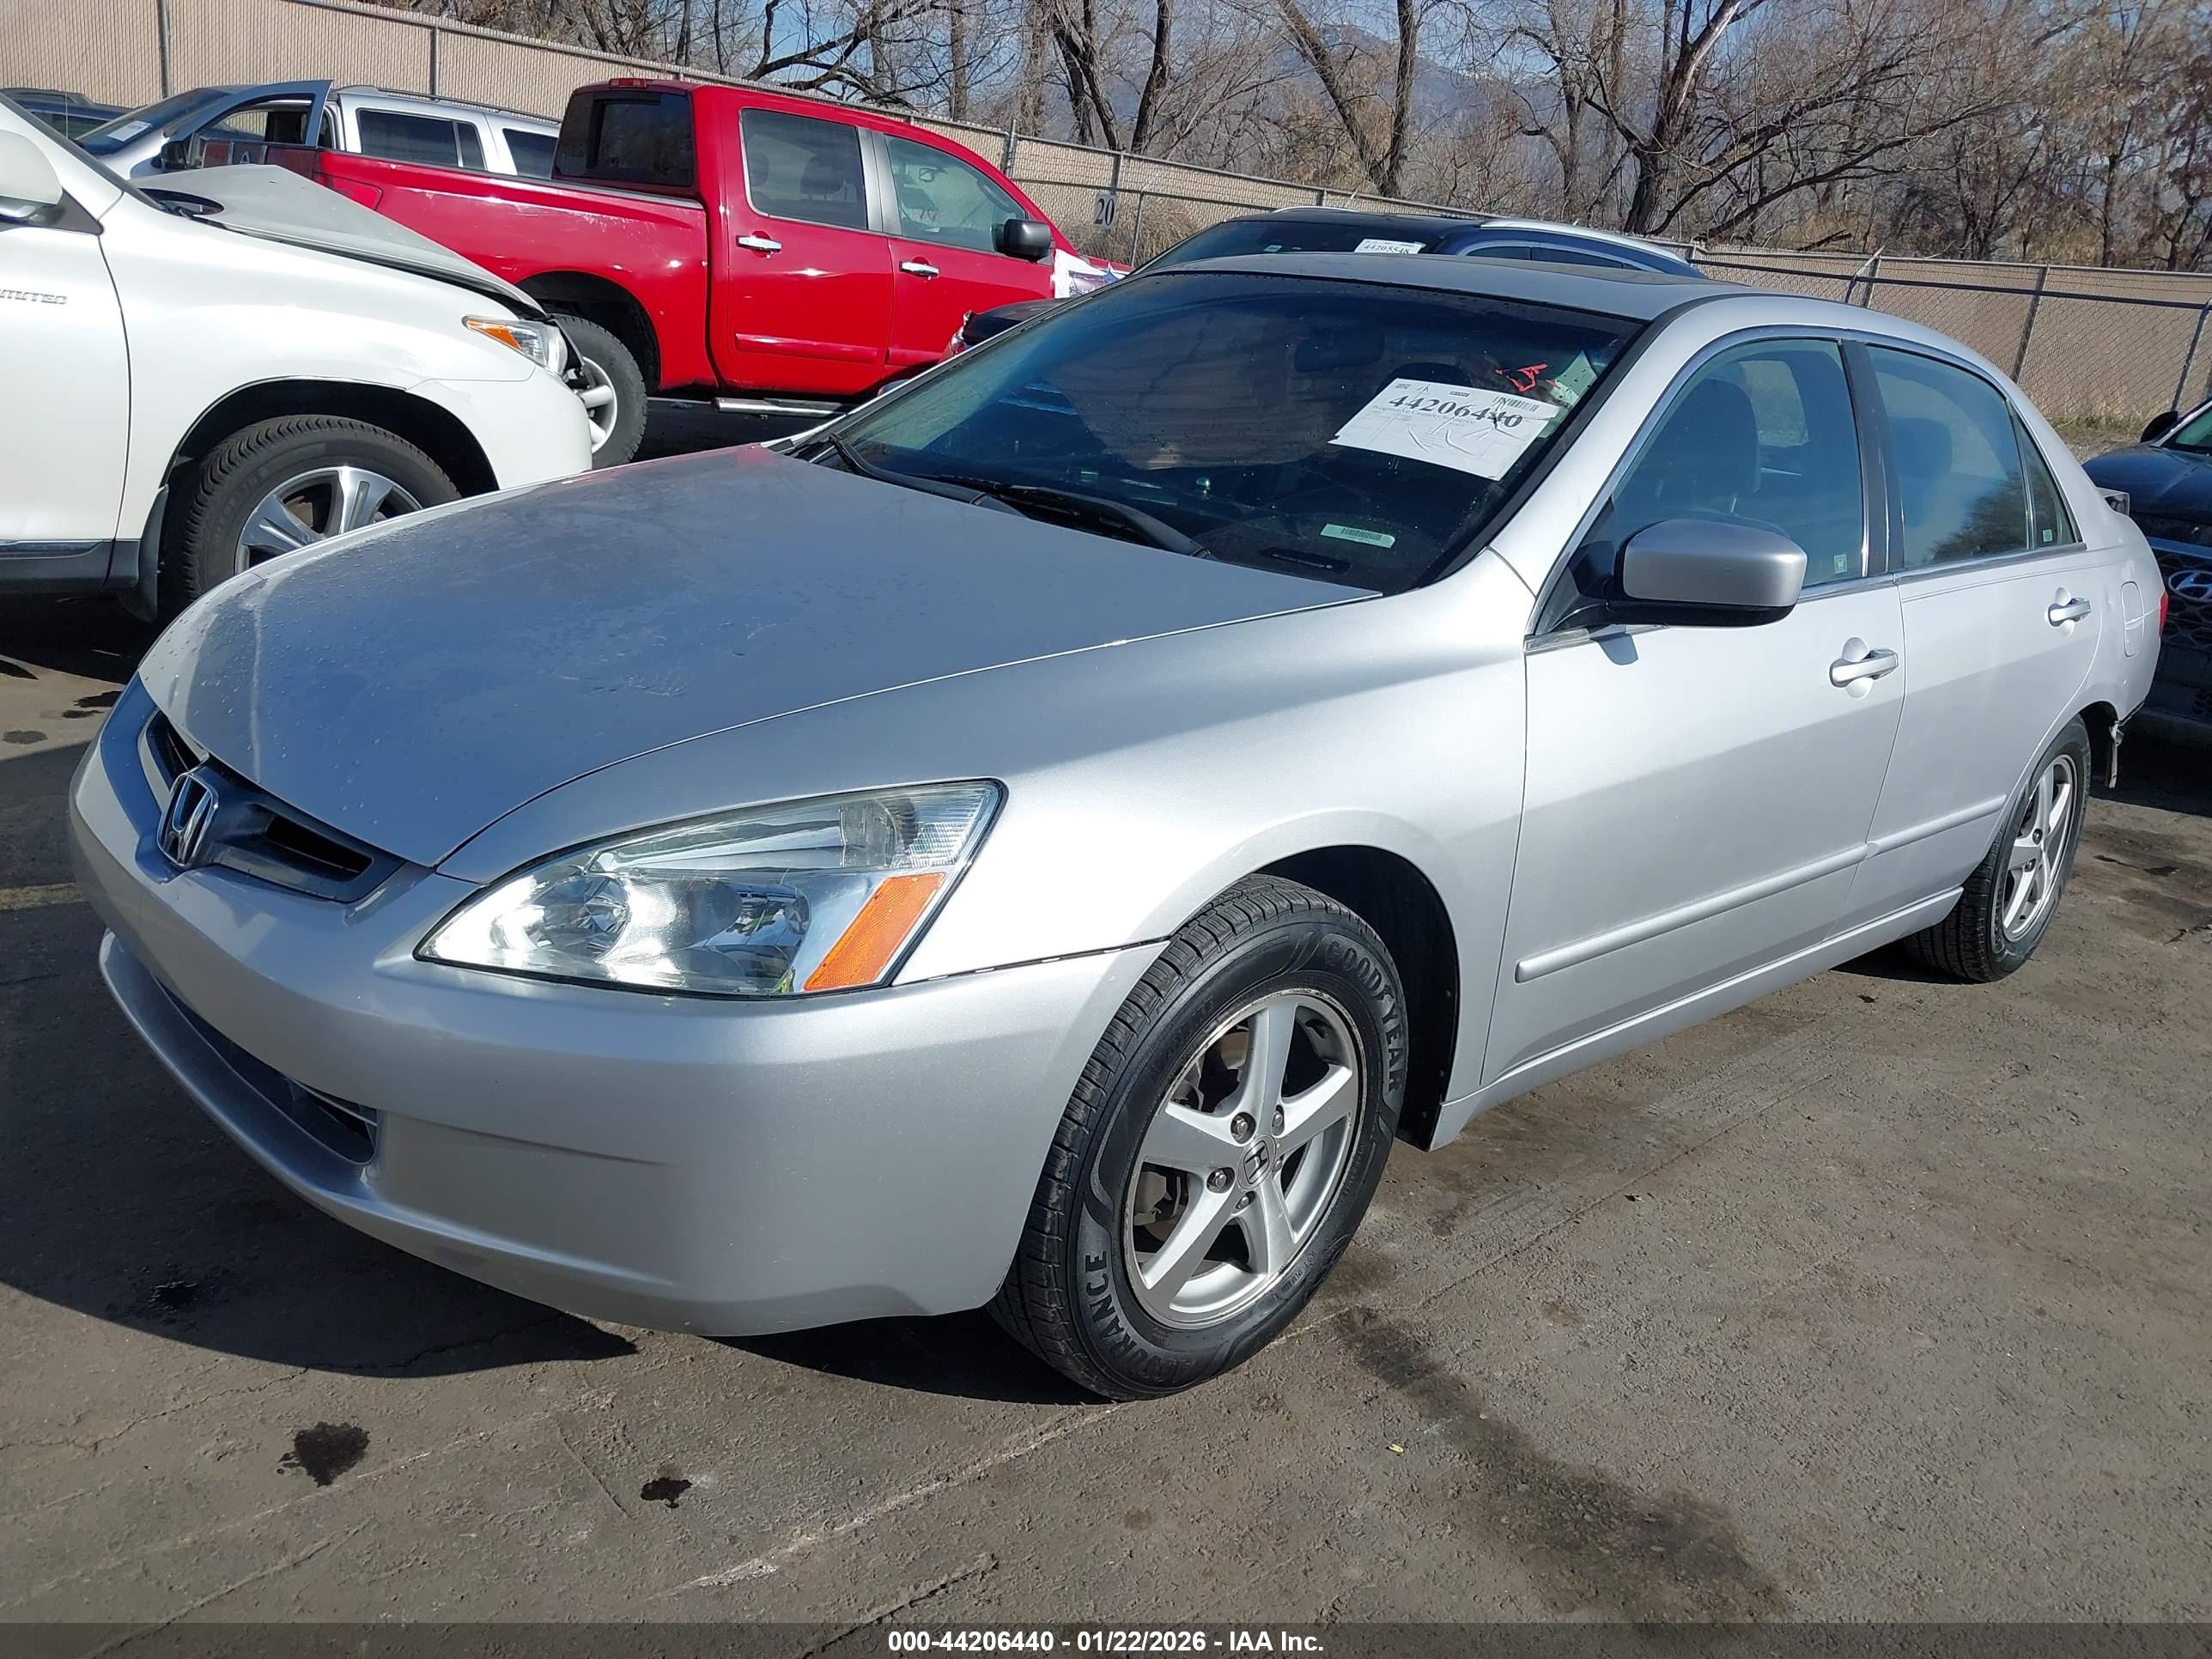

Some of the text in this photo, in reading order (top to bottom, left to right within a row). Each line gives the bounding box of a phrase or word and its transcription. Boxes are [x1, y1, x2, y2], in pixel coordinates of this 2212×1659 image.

[1094, 198, 1115, 226] 20
[0, 289, 68, 305] MITED
[1388, 395, 1524, 428] 44206440
[1325, 940, 1404, 1093] GOODYEAR
